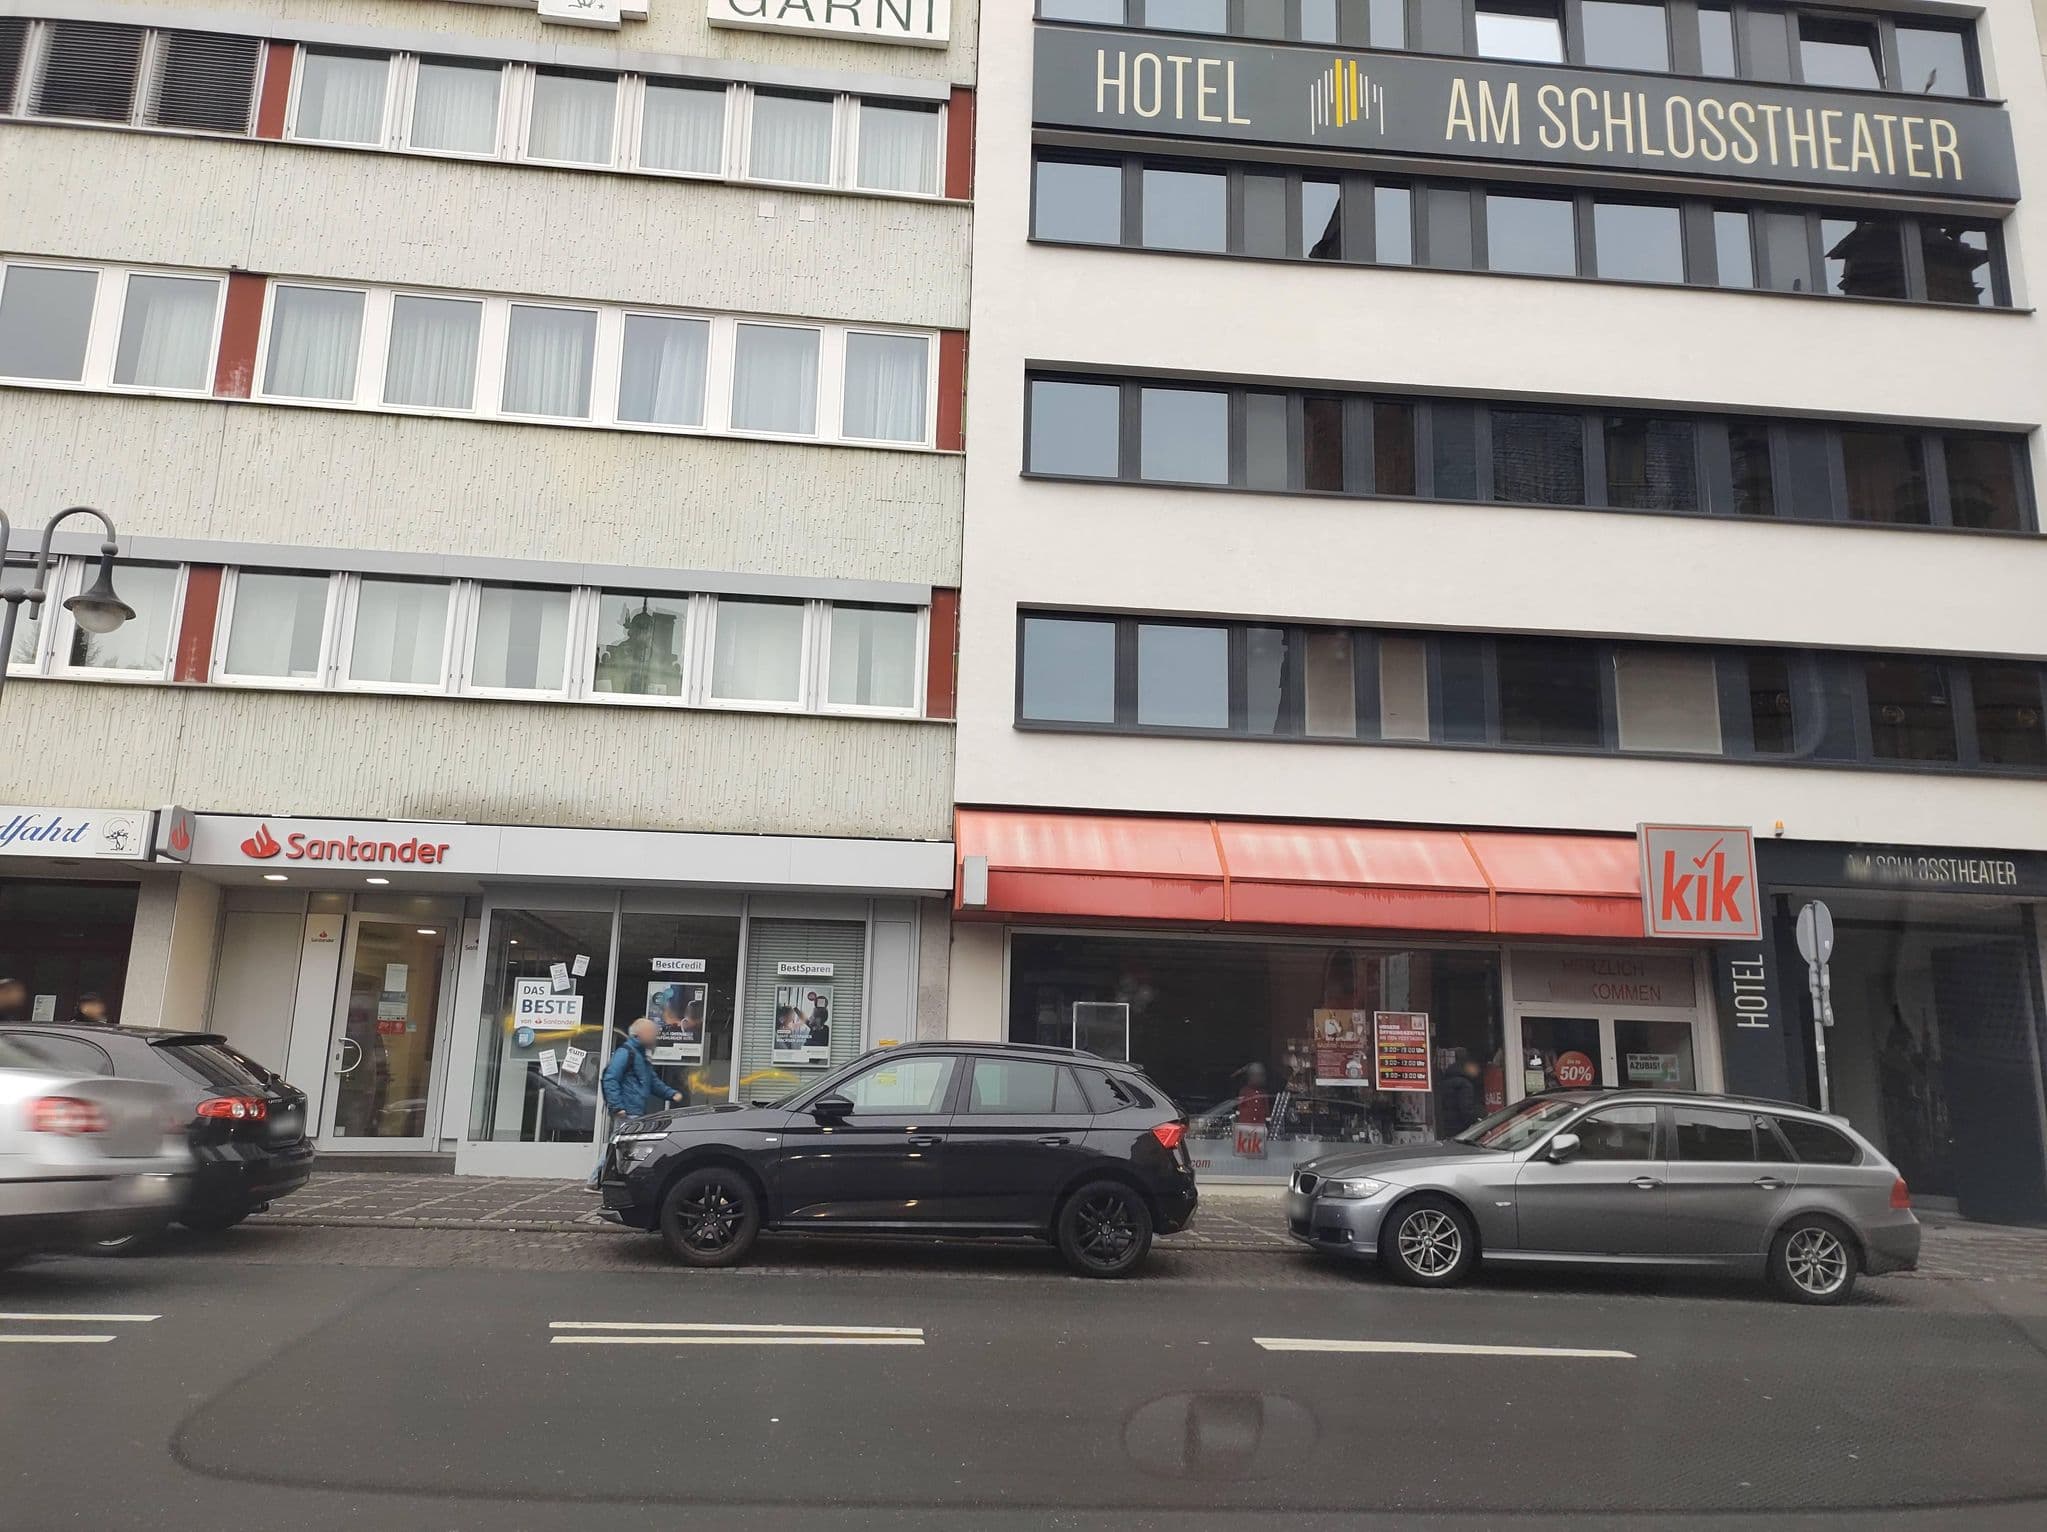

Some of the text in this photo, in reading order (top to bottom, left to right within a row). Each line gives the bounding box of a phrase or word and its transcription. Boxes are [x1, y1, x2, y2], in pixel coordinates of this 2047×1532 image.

[1095, 47, 1253, 126] HOTEL
[1445, 77, 1965, 182] AM SCHLOSSTHEATER
[286, 832, 450, 865] Santander
[655, 960, 703, 971] BestCredit
[780, 963, 832, 975] BestSparen
[523, 986, 545, 996] DAS
[1730, 953, 1770, 1029] HOTEL
[522, 999, 577, 1015] BESTE
[1559, 1066, 1592, 1082] 50%
